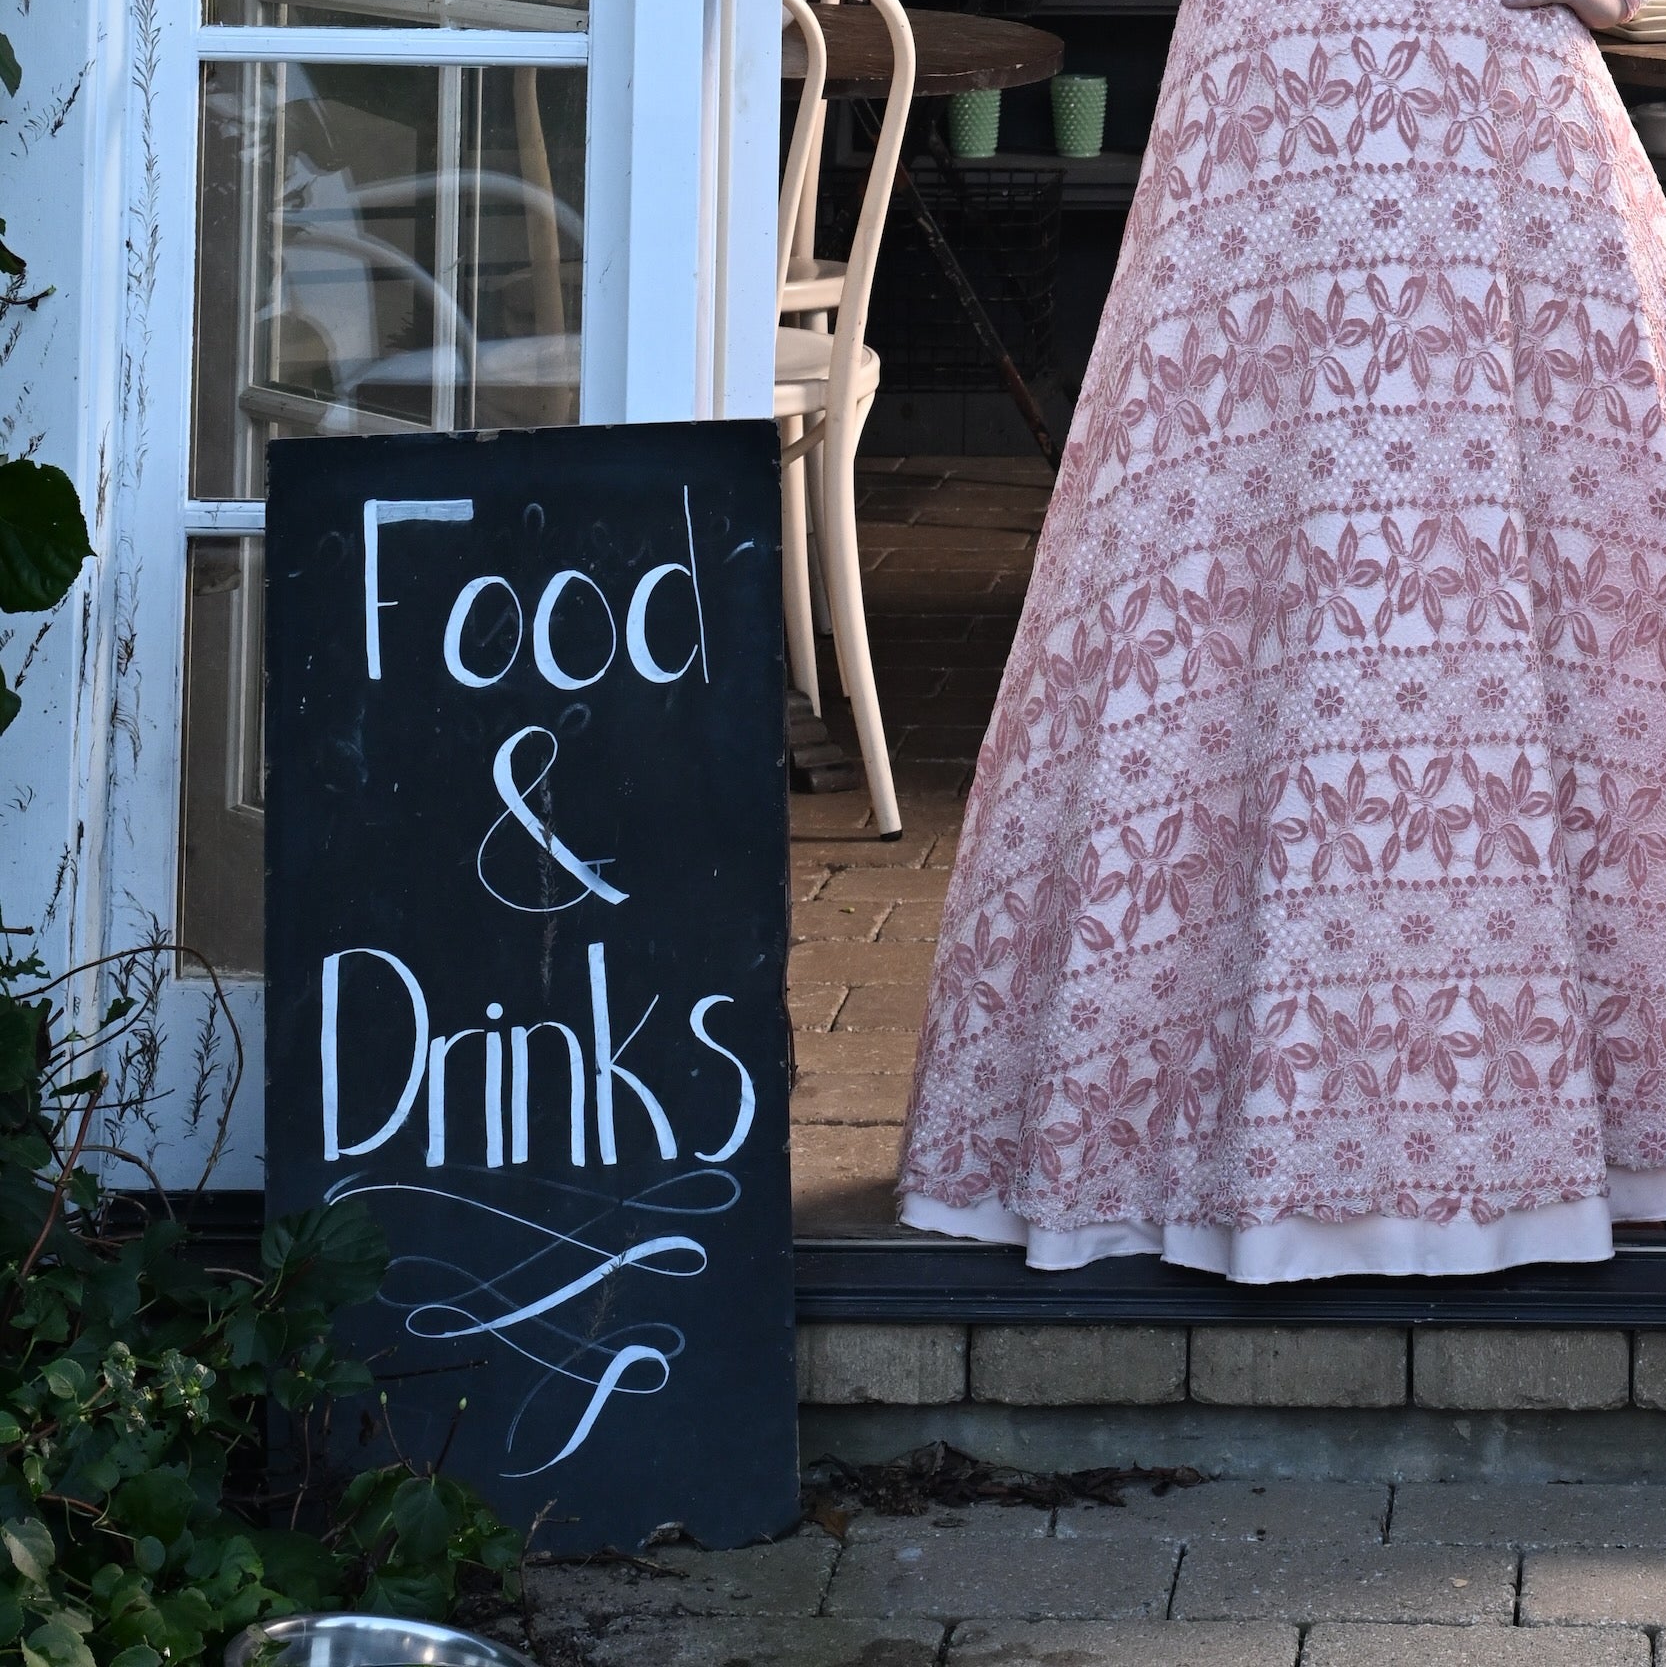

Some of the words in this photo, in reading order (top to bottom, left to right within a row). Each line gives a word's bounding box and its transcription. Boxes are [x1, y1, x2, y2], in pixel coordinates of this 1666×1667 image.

[363, 485, 711, 690] Food
[476, 725, 630, 912] &
[320, 942, 757, 1168] Drinks
